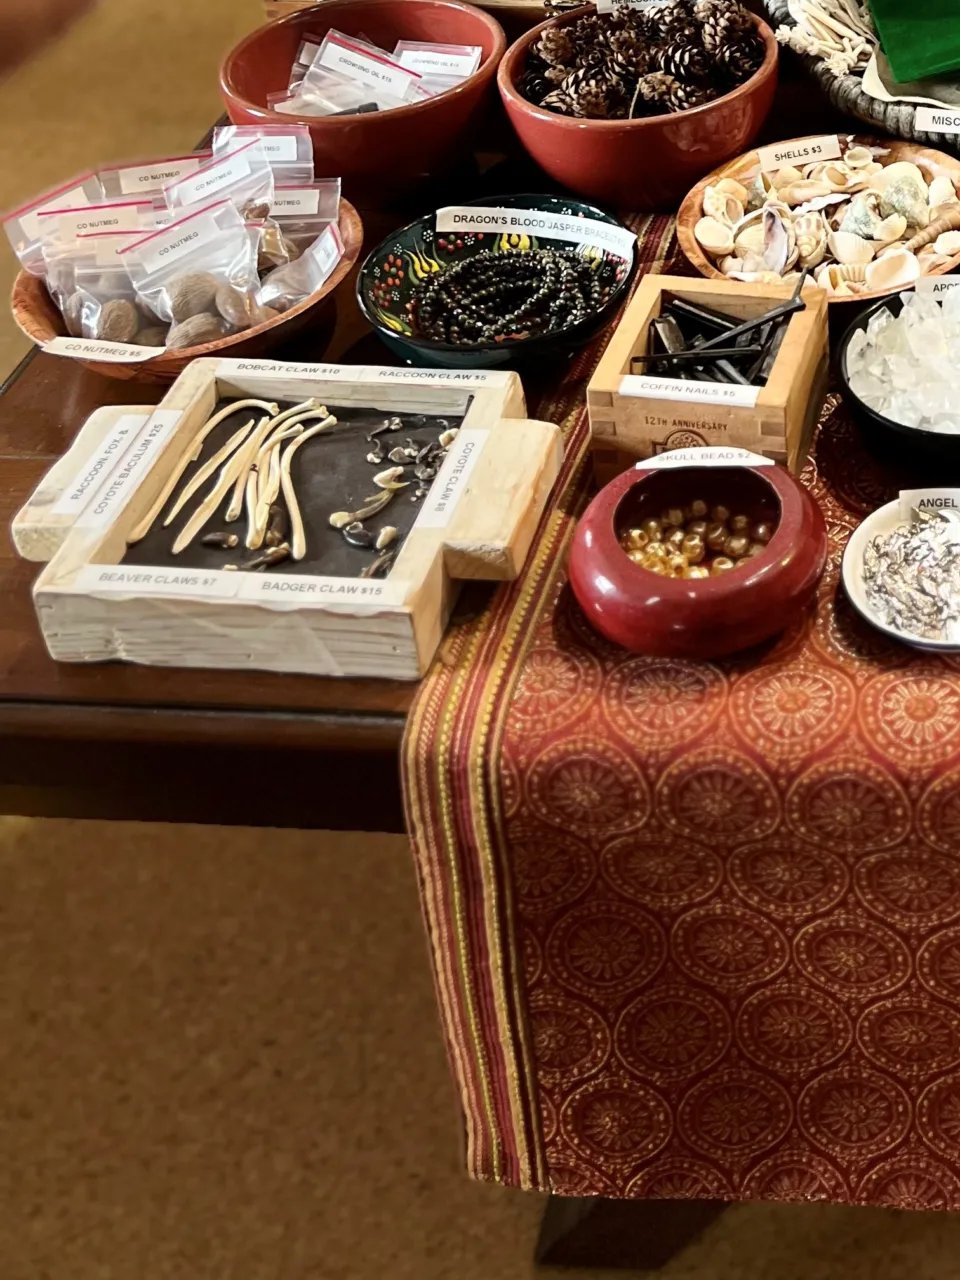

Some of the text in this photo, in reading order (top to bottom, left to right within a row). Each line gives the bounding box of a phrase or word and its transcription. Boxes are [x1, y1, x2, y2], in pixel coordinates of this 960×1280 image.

[932, 115, 960, 126] MISC
[774, 145, 822, 161] SHELLS $3
[150, 170, 180, 180] NUTMEG
[453, 214, 582, 232] DRAGON'S BLOOD JASPER
[158, 231, 199, 256] CO NUTMEG
[82, 346, 128, 356] NUTMEG
[236, 363, 283, 371] BOBCAT
[378, 369, 436, 379] RACCOON
[640, 382, 682, 392] COFFIN
[685, 386, 718, 395] NAILS
[644, 415, 727, 431] 12TH ANNIVERSARY
[452, 442, 475, 474] COYOTE
[657, 452, 695, 461] SKULL
[93, 424, 163, 514] COYOTE BACULUM $25
[440, 475, 459, 501] CLAW
[918, 498, 958, 509] ANGEL
[98, 572, 217, 585] BEAVER CLAWS $7
[261, 581, 382, 595] BADGER CLAW $15
